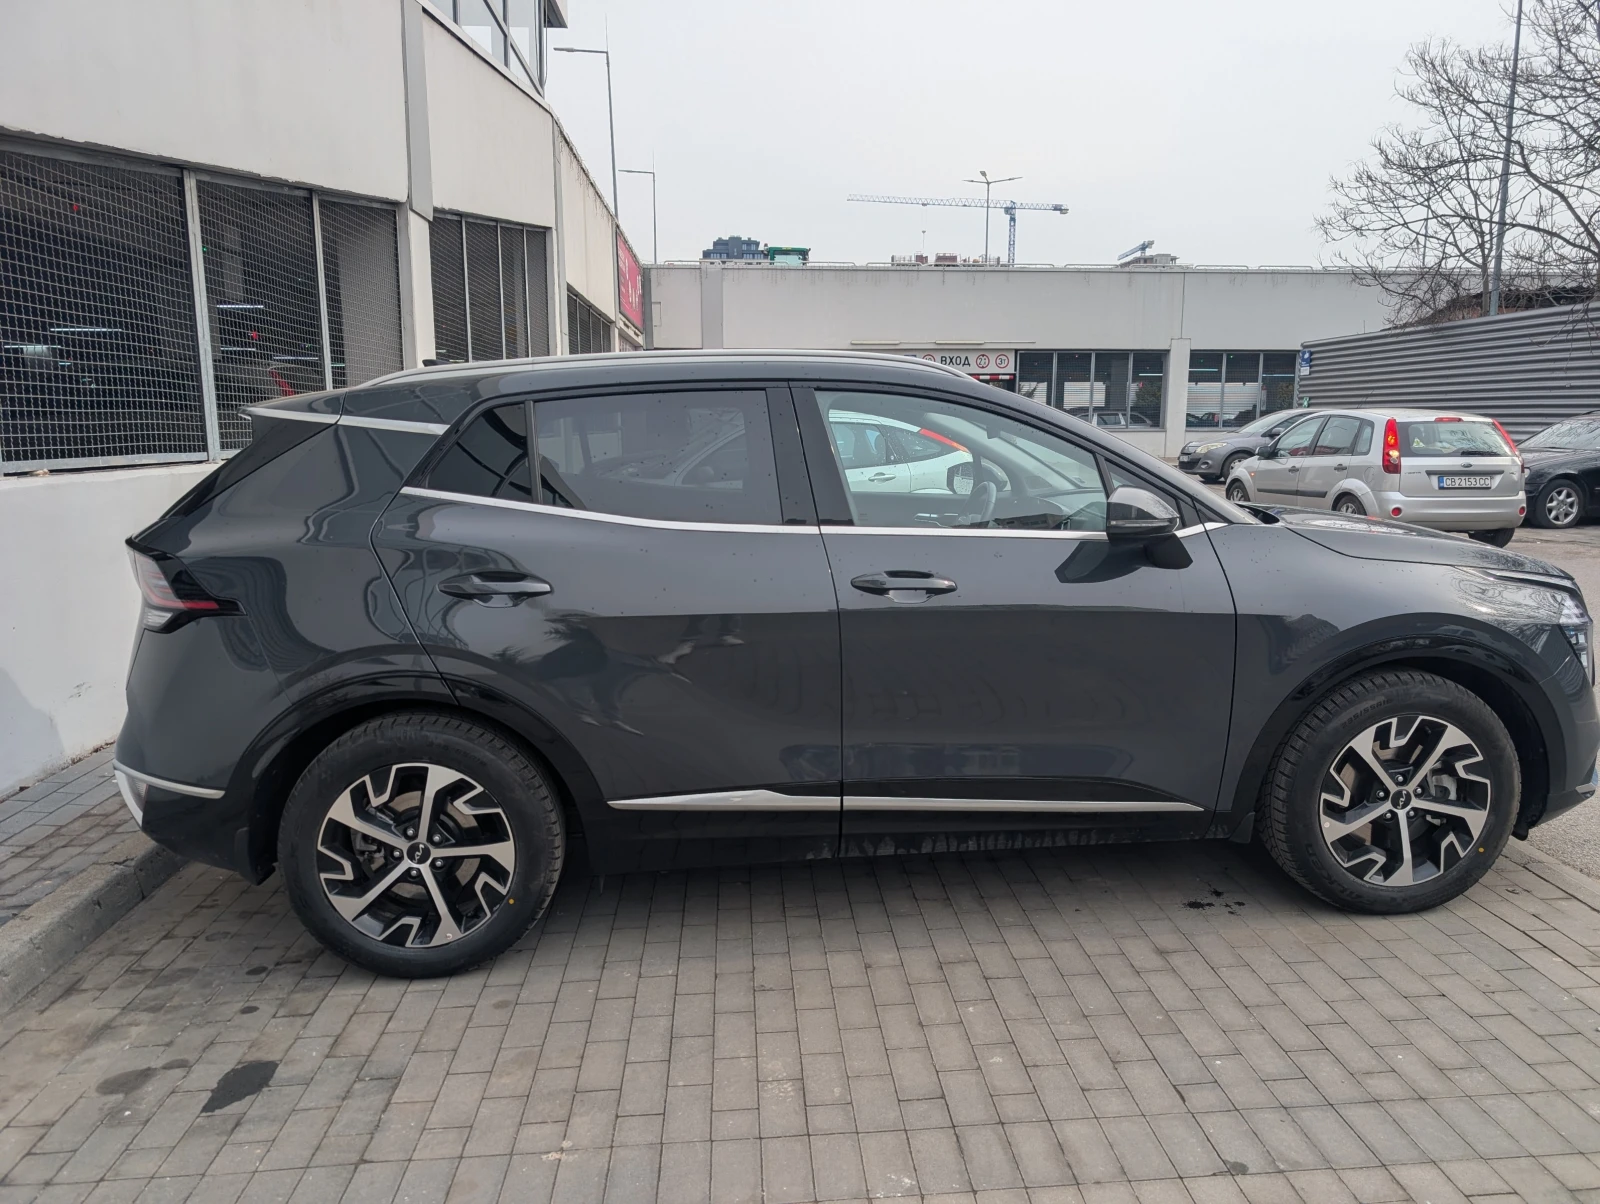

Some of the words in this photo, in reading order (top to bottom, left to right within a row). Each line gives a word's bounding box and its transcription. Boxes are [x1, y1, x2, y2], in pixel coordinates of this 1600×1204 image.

[940, 356, 971, 367] ВХОД
[1445, 477, 1456, 487] CB
[1458, 477, 1478, 487] 2153
[1478, 477, 1490, 487] CC
